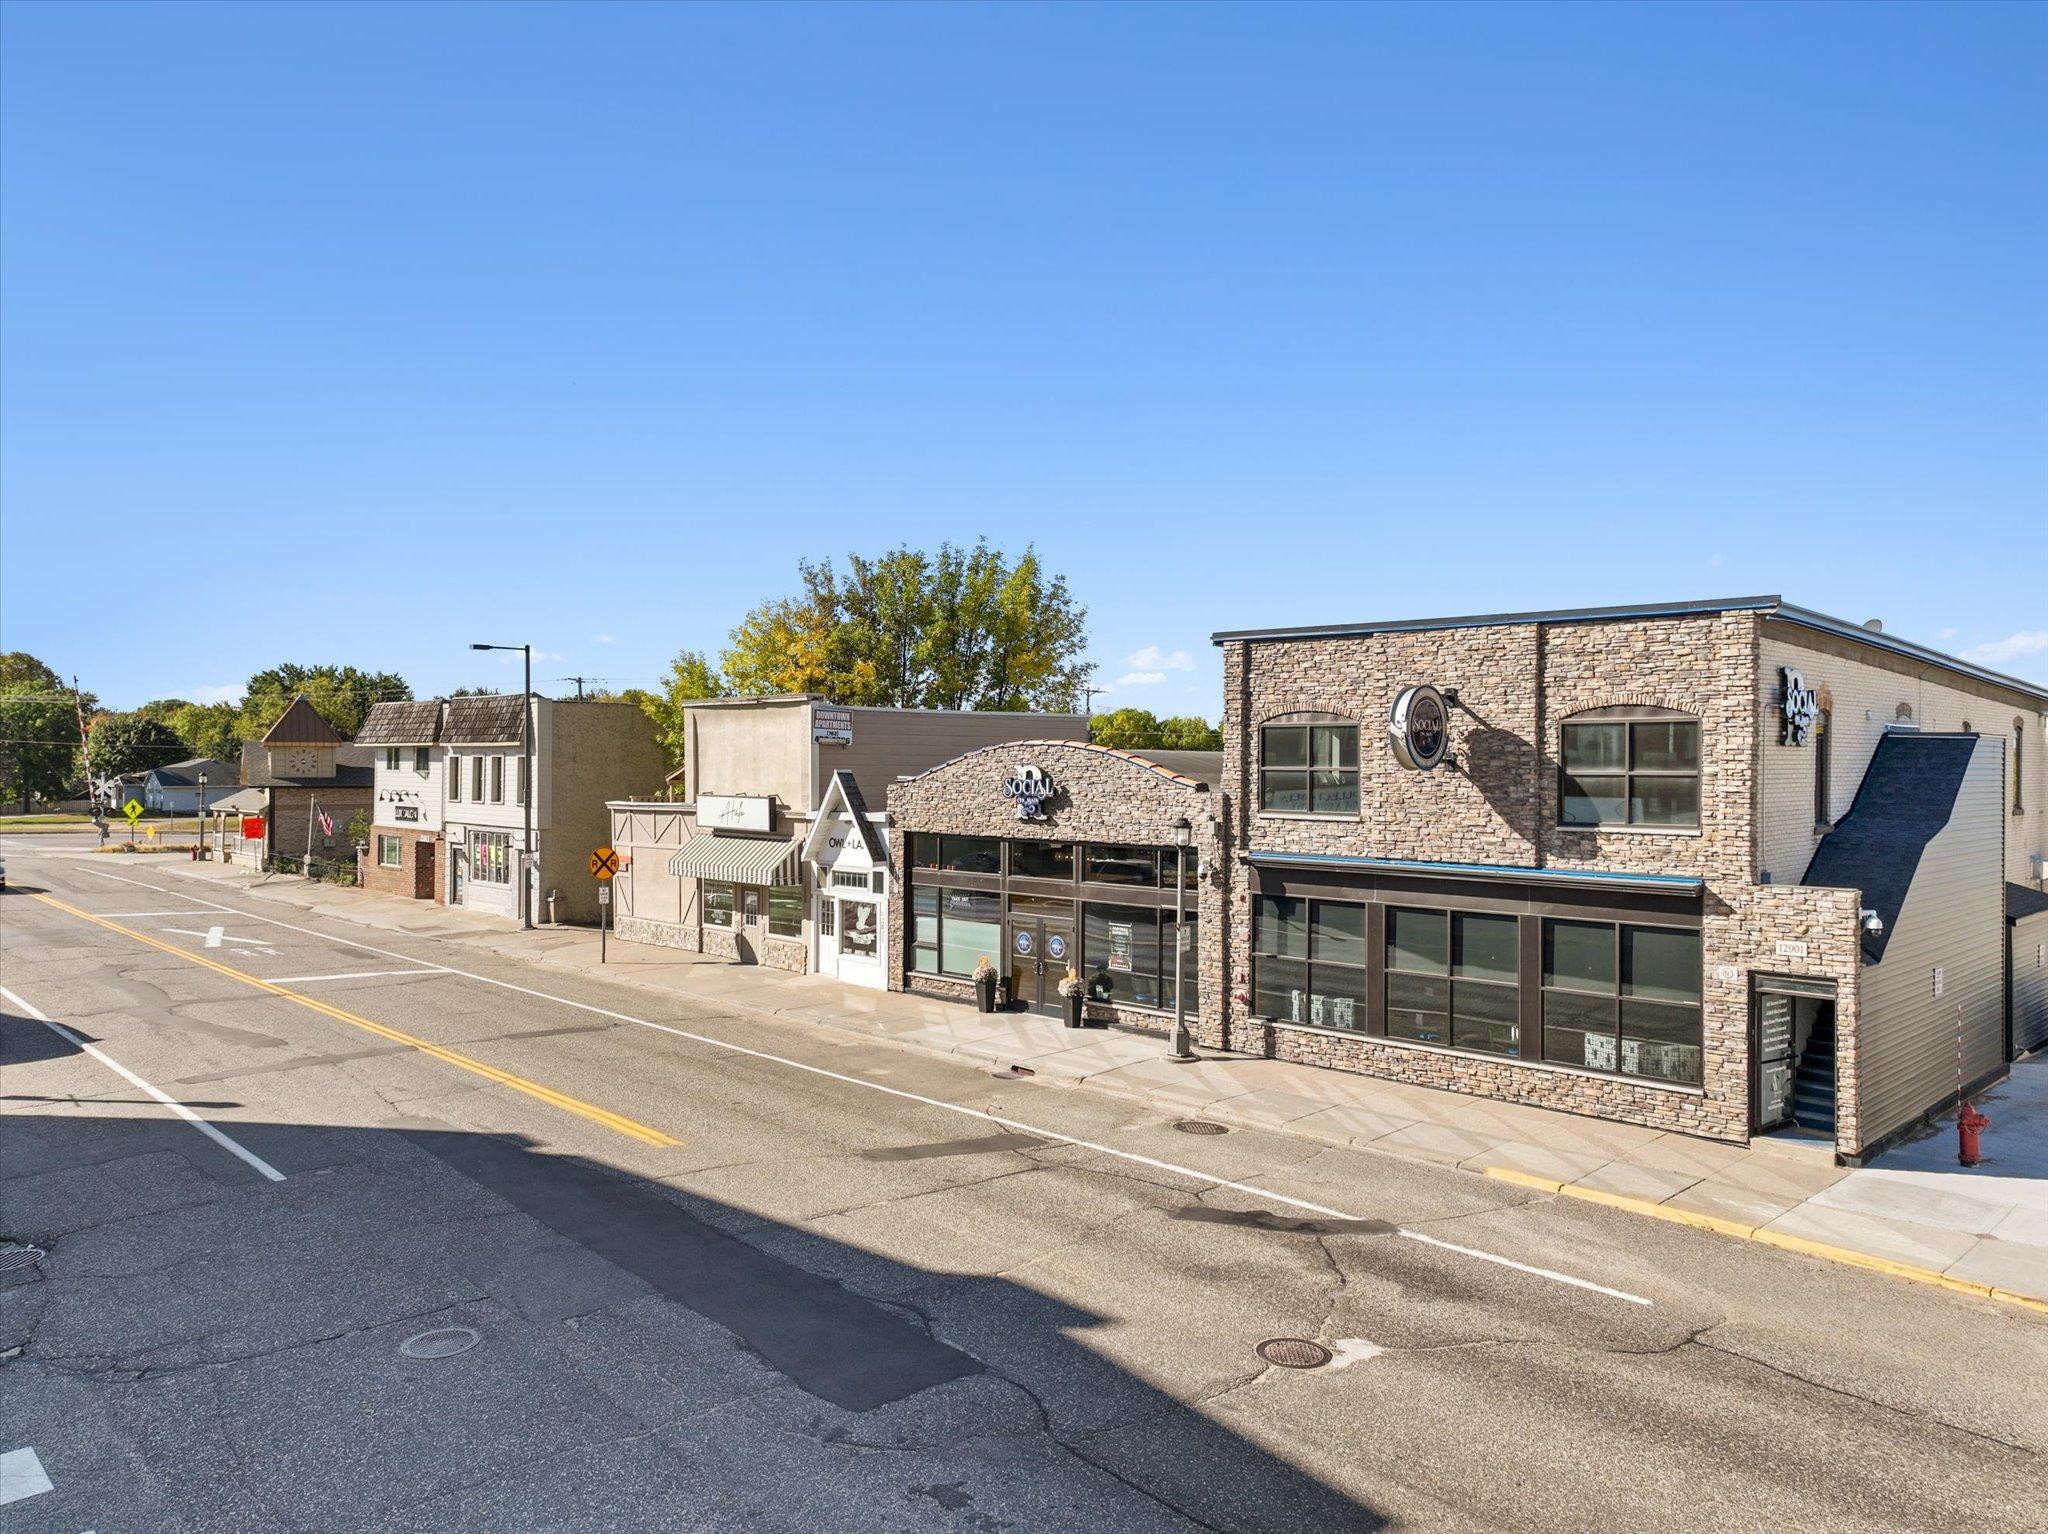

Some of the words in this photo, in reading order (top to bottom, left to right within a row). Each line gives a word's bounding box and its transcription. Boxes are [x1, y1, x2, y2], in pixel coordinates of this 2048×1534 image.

[816, 711, 850, 721] DOWNTOWN
[814, 719, 851, 730] APARTMENTS
[1412, 719, 1440, 734] SOCIAL
[1003, 777, 1054, 801] SOCIAL
[828, 837, 846, 849] OWL
[1779, 943, 1804, 954] 12901
